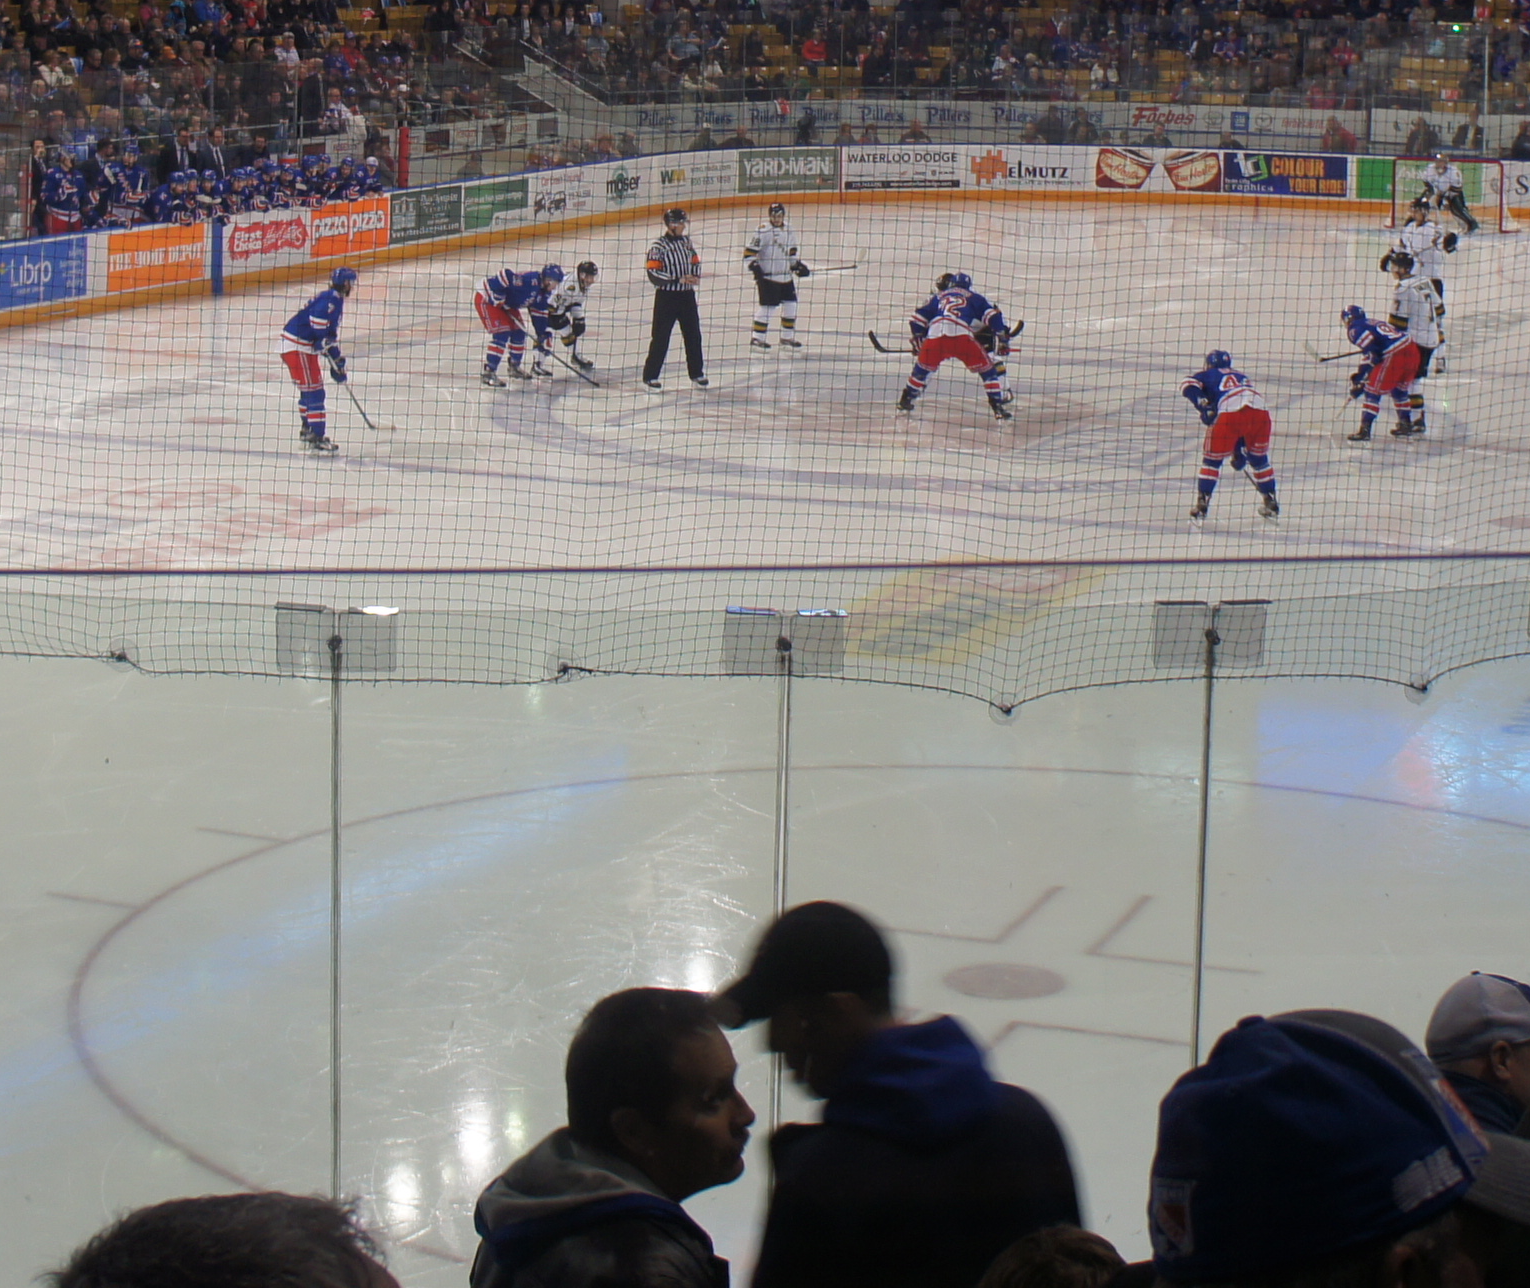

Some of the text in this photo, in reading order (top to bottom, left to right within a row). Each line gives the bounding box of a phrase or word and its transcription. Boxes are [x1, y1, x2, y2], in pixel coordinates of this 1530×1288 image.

[1132, 107, 1194, 127] Forbes
[848, 152, 958, 164] WATERLOO DODGE
[1272, 157, 1324, 177] COLOUR
[606, 174, 641, 195] moser
[1289, 178, 1317, 194] YOUR
[235, 229, 262, 242] First
[313, 213, 347, 246] pizza
[349, 210, 385, 242] pizza
[234, 240, 262, 252] Choice
[110, 241, 209, 272] THE HOME DEPOT
